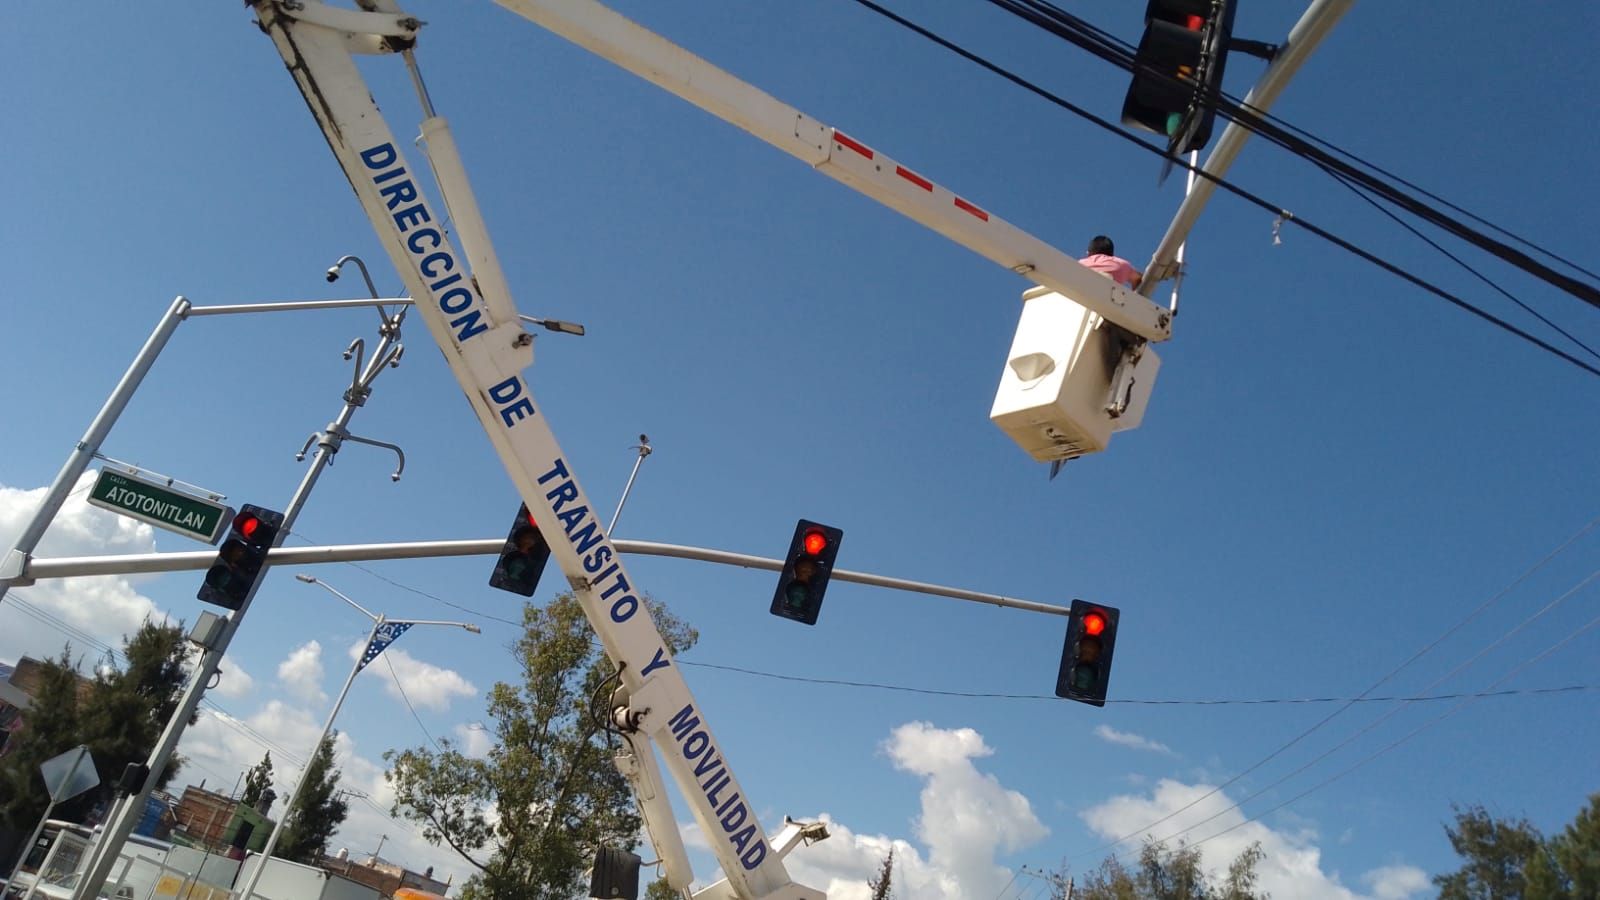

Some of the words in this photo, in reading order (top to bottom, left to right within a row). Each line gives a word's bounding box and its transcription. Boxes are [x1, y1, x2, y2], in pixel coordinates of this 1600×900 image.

[106, 486, 205, 529] ATOTONITLAN
[360, 142, 488, 341] DIRECCION
[488, 376, 534, 427] DE
[537, 459, 638, 623] TRANSITO
[641, 648, 670, 676] Y
[668, 704, 767, 870] MOVILIDAD
